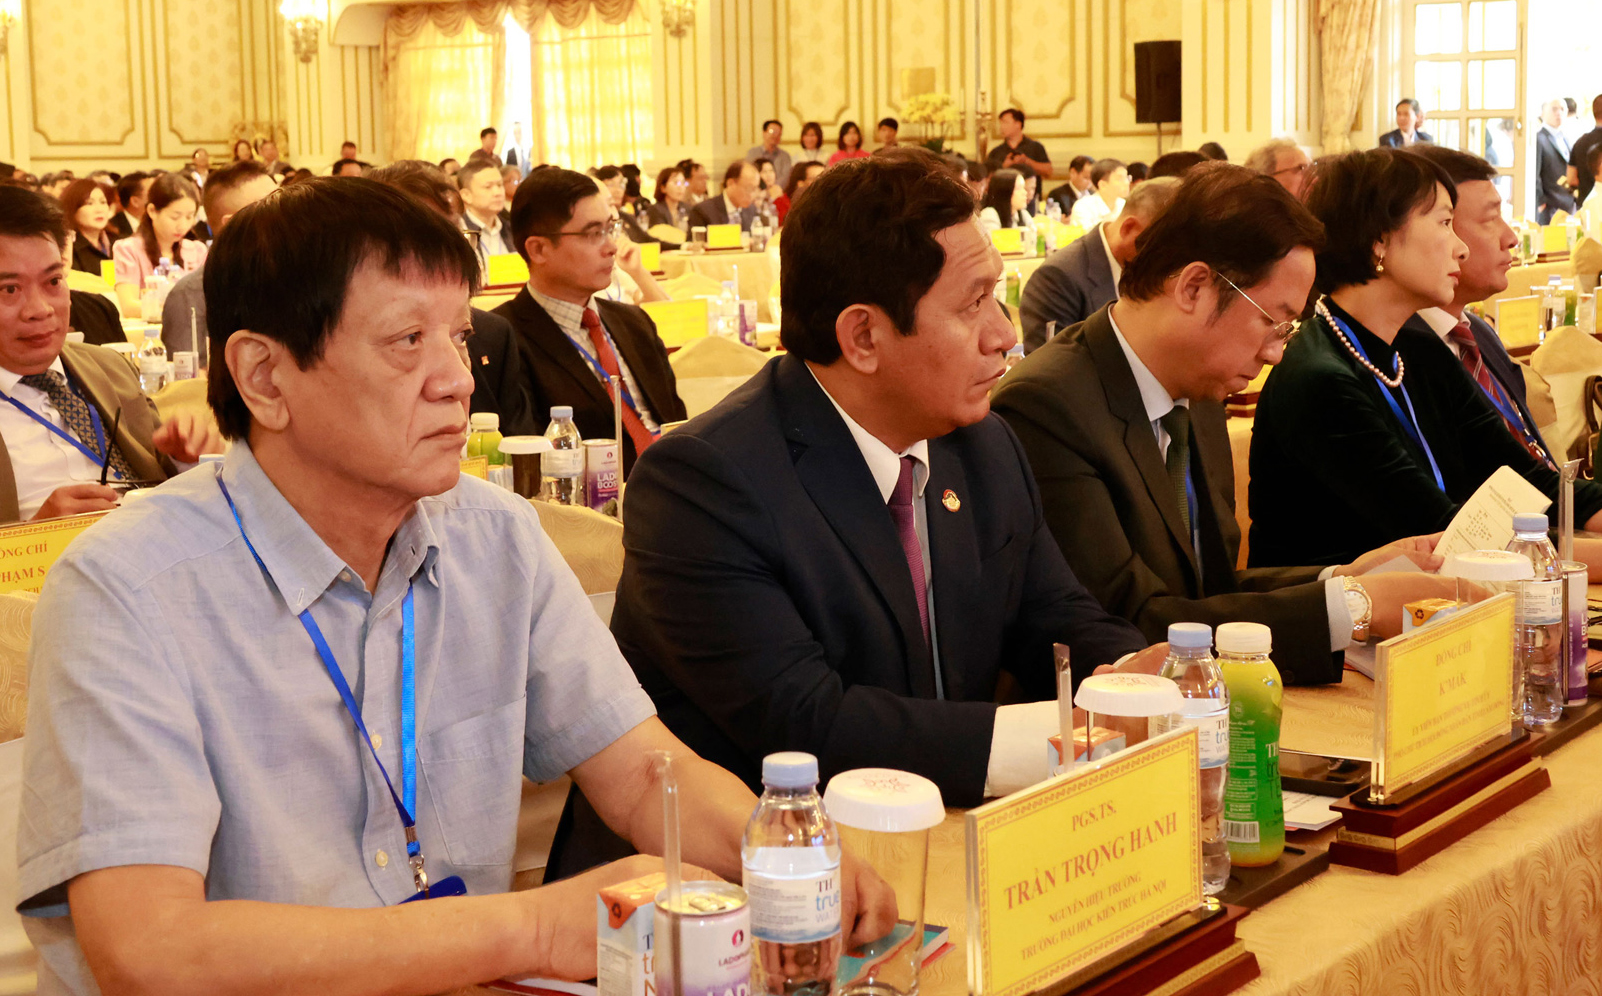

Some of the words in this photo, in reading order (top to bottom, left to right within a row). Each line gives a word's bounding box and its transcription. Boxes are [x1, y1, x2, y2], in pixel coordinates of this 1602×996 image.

[597, 472, 617, 482] LAD
[26, 540, 47, 555] CHÍ
[0, 567, 33, 584] HẠM
[1072, 800, 1116, 832] PGS.TS.
[1004, 866, 1056, 909] TRẦN
[1062, 836, 1125, 882] TRỌNG
[1130, 811, 1177, 852] HANH
[642, 932, 655, 950] T
